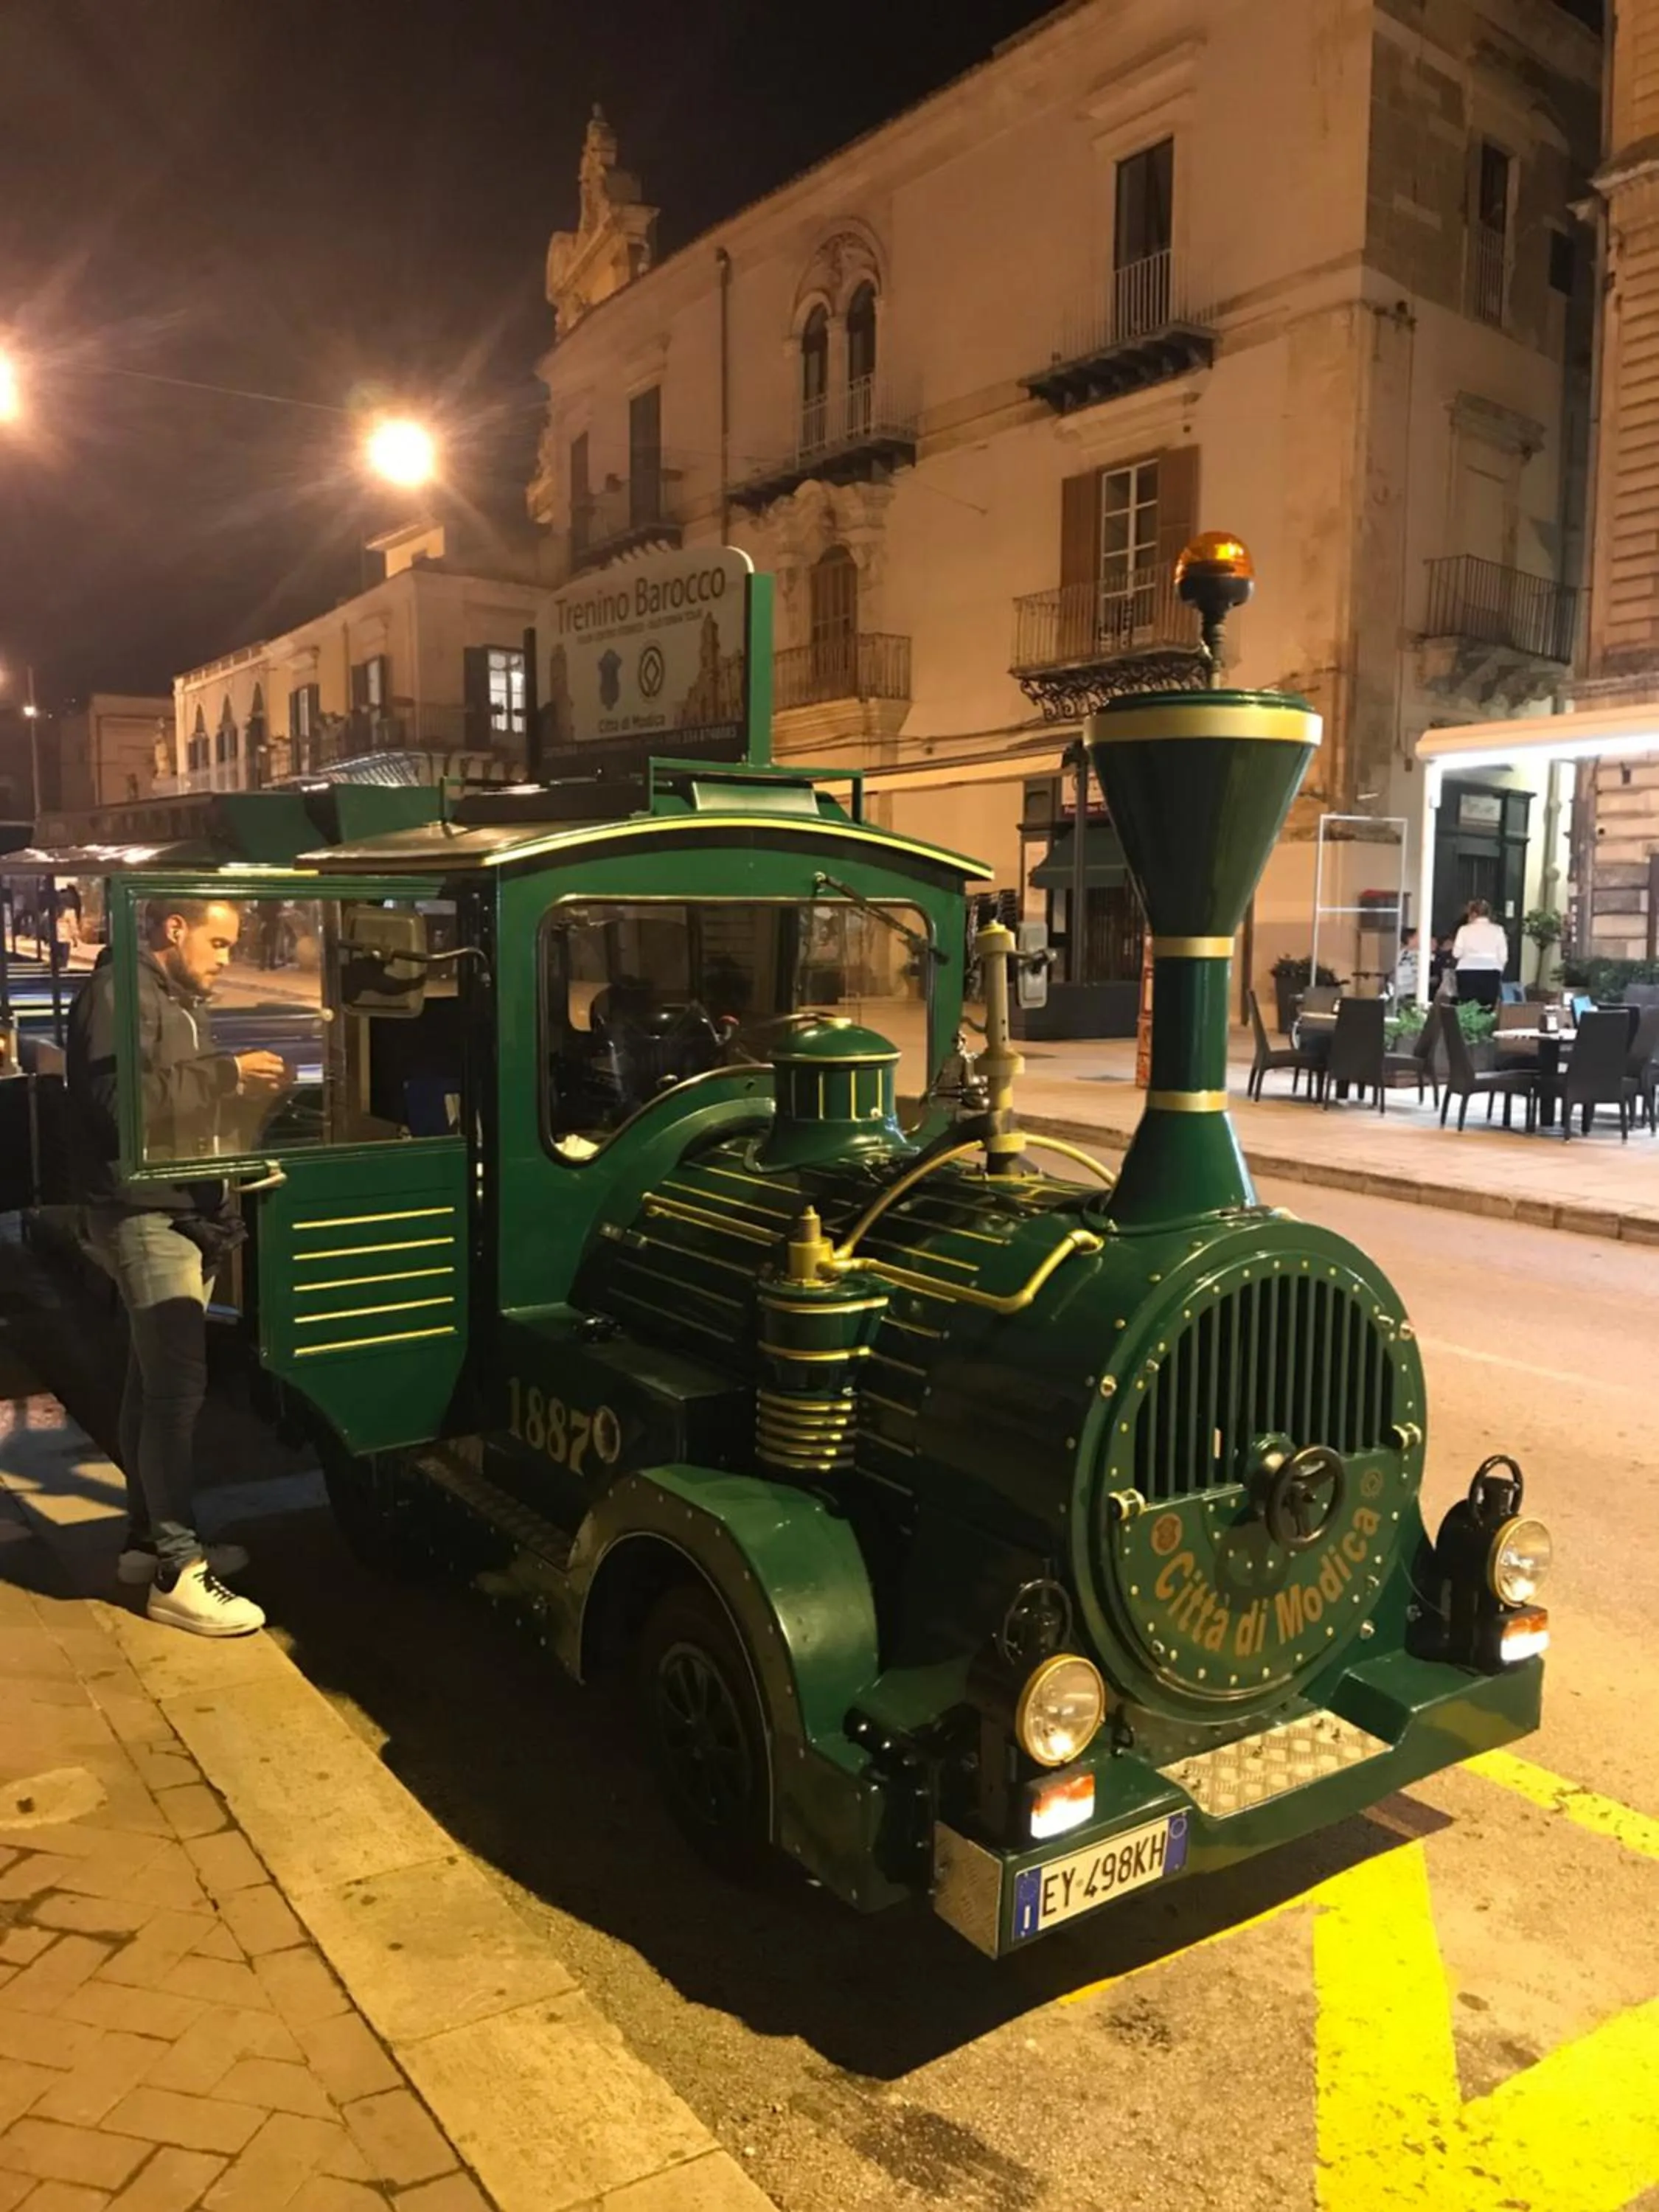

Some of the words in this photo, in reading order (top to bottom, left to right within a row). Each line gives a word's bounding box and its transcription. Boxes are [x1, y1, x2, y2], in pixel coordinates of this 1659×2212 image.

[554, 591, 630, 634] Trenino
[635, 566, 726, 617] Barocco
[1235, 1598, 1269, 1657] di
[1275, 1507, 1382, 1645] Modica
